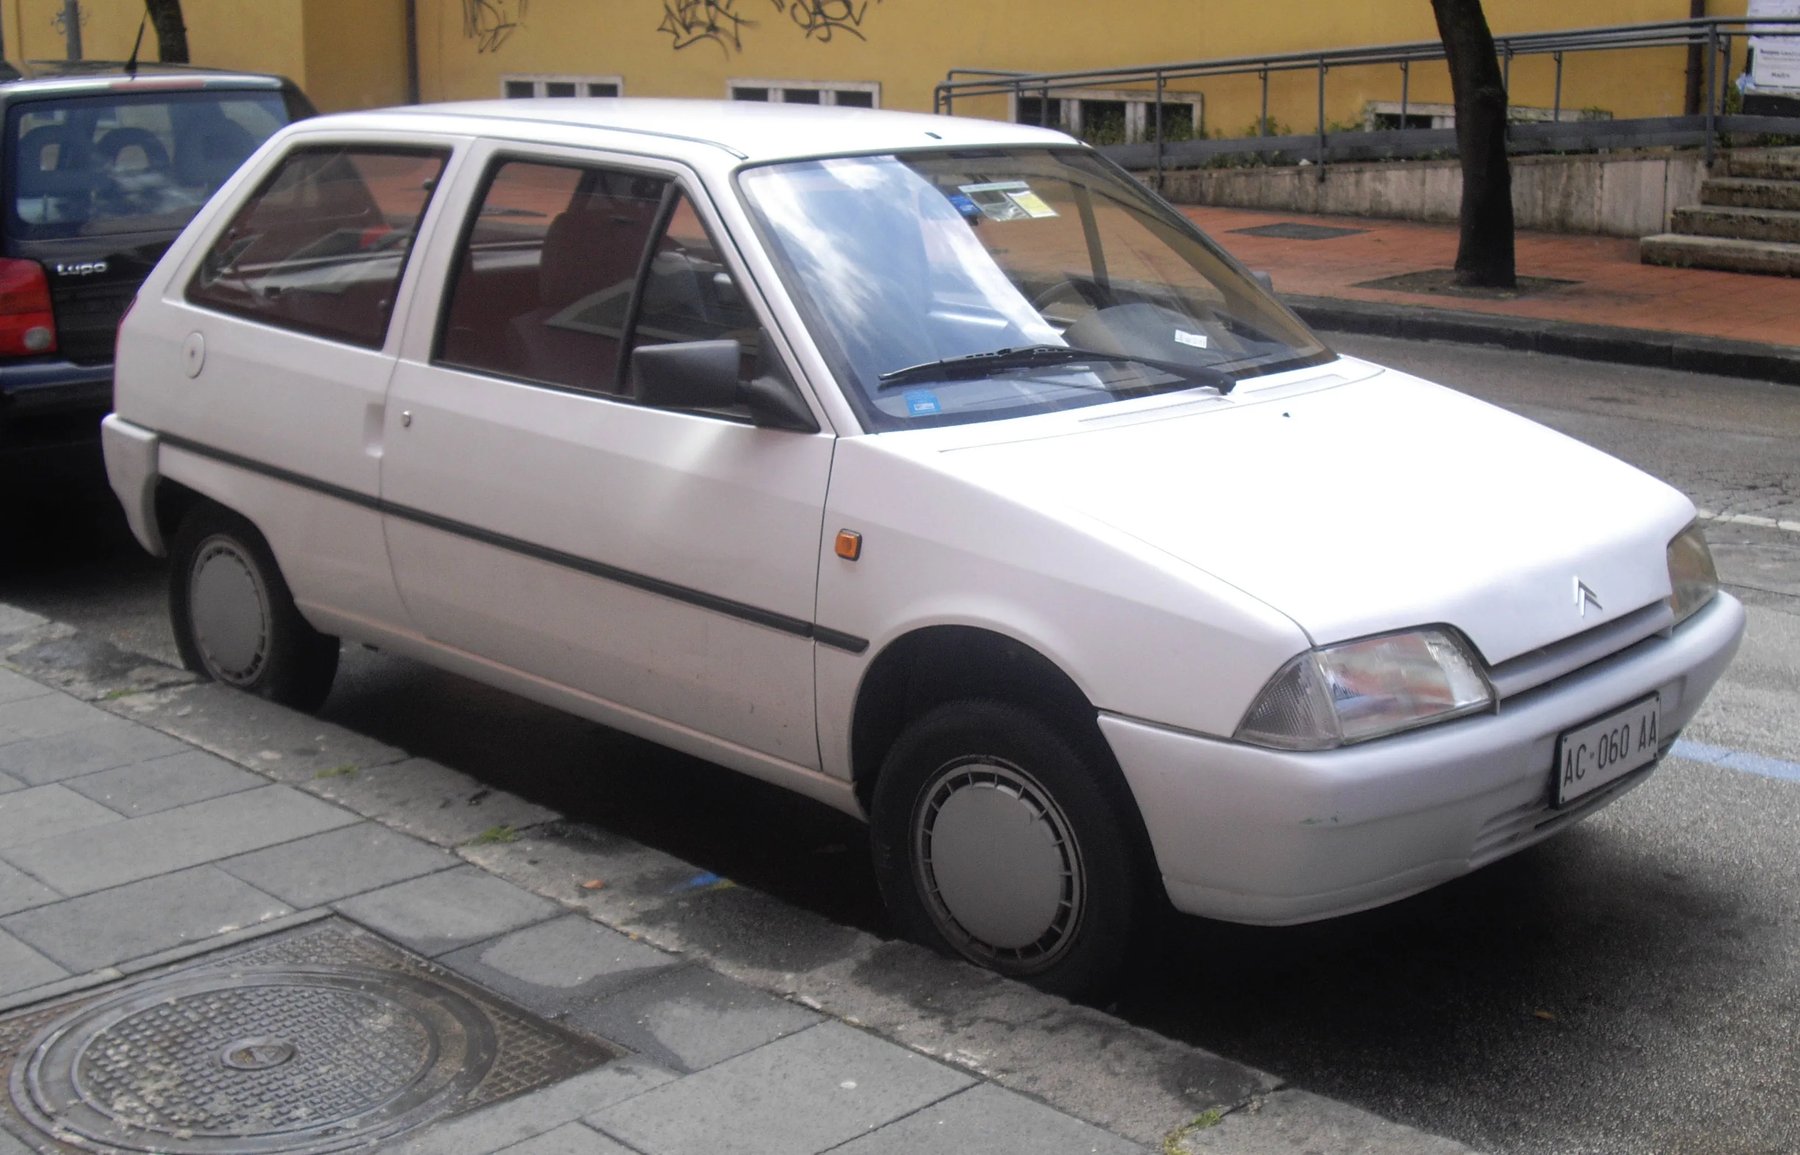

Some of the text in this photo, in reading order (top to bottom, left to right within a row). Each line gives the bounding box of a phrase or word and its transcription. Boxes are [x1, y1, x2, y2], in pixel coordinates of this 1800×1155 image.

[1563, 710, 1657, 787] AC 060 AA
